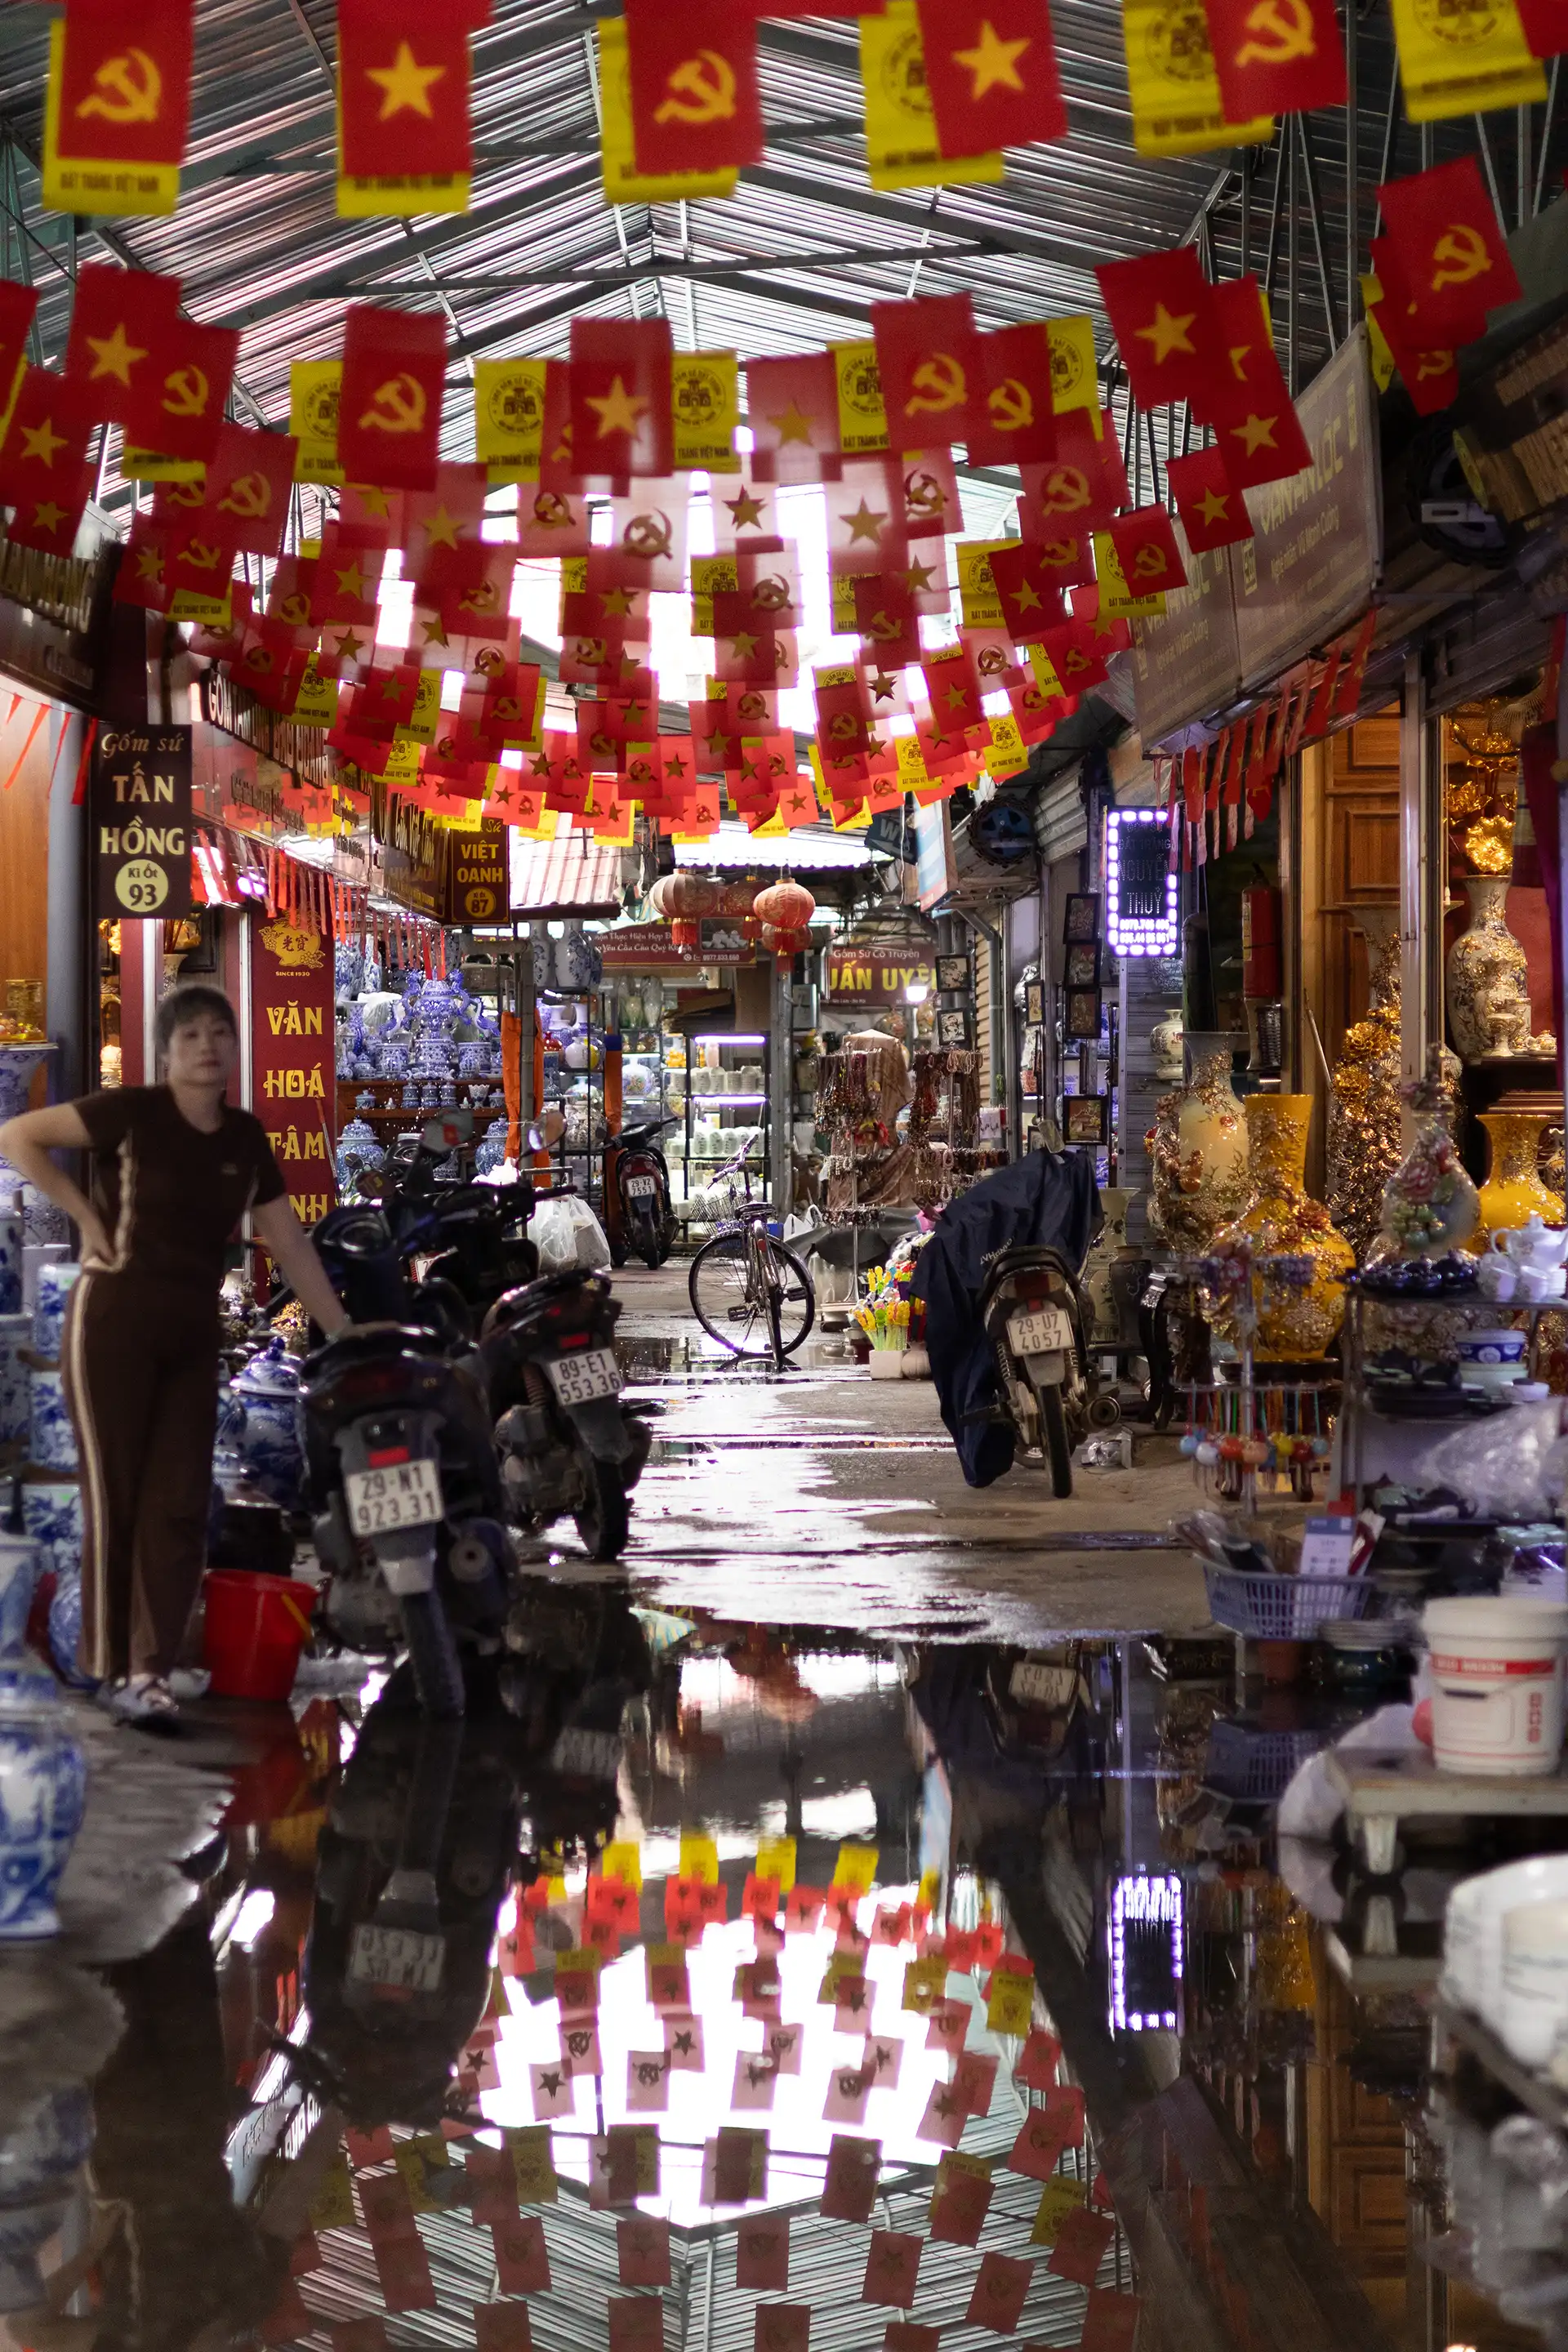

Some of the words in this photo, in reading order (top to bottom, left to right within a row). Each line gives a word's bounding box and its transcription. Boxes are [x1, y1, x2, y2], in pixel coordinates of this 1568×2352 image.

[100, 730, 149, 759] Gốm
[157, 732, 185, 753] sứ
[112, 760, 175, 803] TẤN
[100, 815, 185, 856] HỒNG
[461, 840, 499, 862] VIỆT
[457, 867, 503, 882] OANH
[129, 884, 158, 906] 93
[471, 899, 488, 913] 87
[833, 947, 856, 958] Gốm
[265, 1000, 323, 1036] VĂN
[263, 1062, 325, 1098] HOÁ
[266, 1125, 325, 1160] TÂM
[631, 1186, 653, 1196] 7551
[1017, 1313, 1059, 1335] 29-U7
[1021, 1330, 1062, 1352] 4057
[559, 1353, 608, 1380] 89-E1
[559, 1372, 620, 1405] 553.36
[358, 1493, 436, 1530] 923.31
